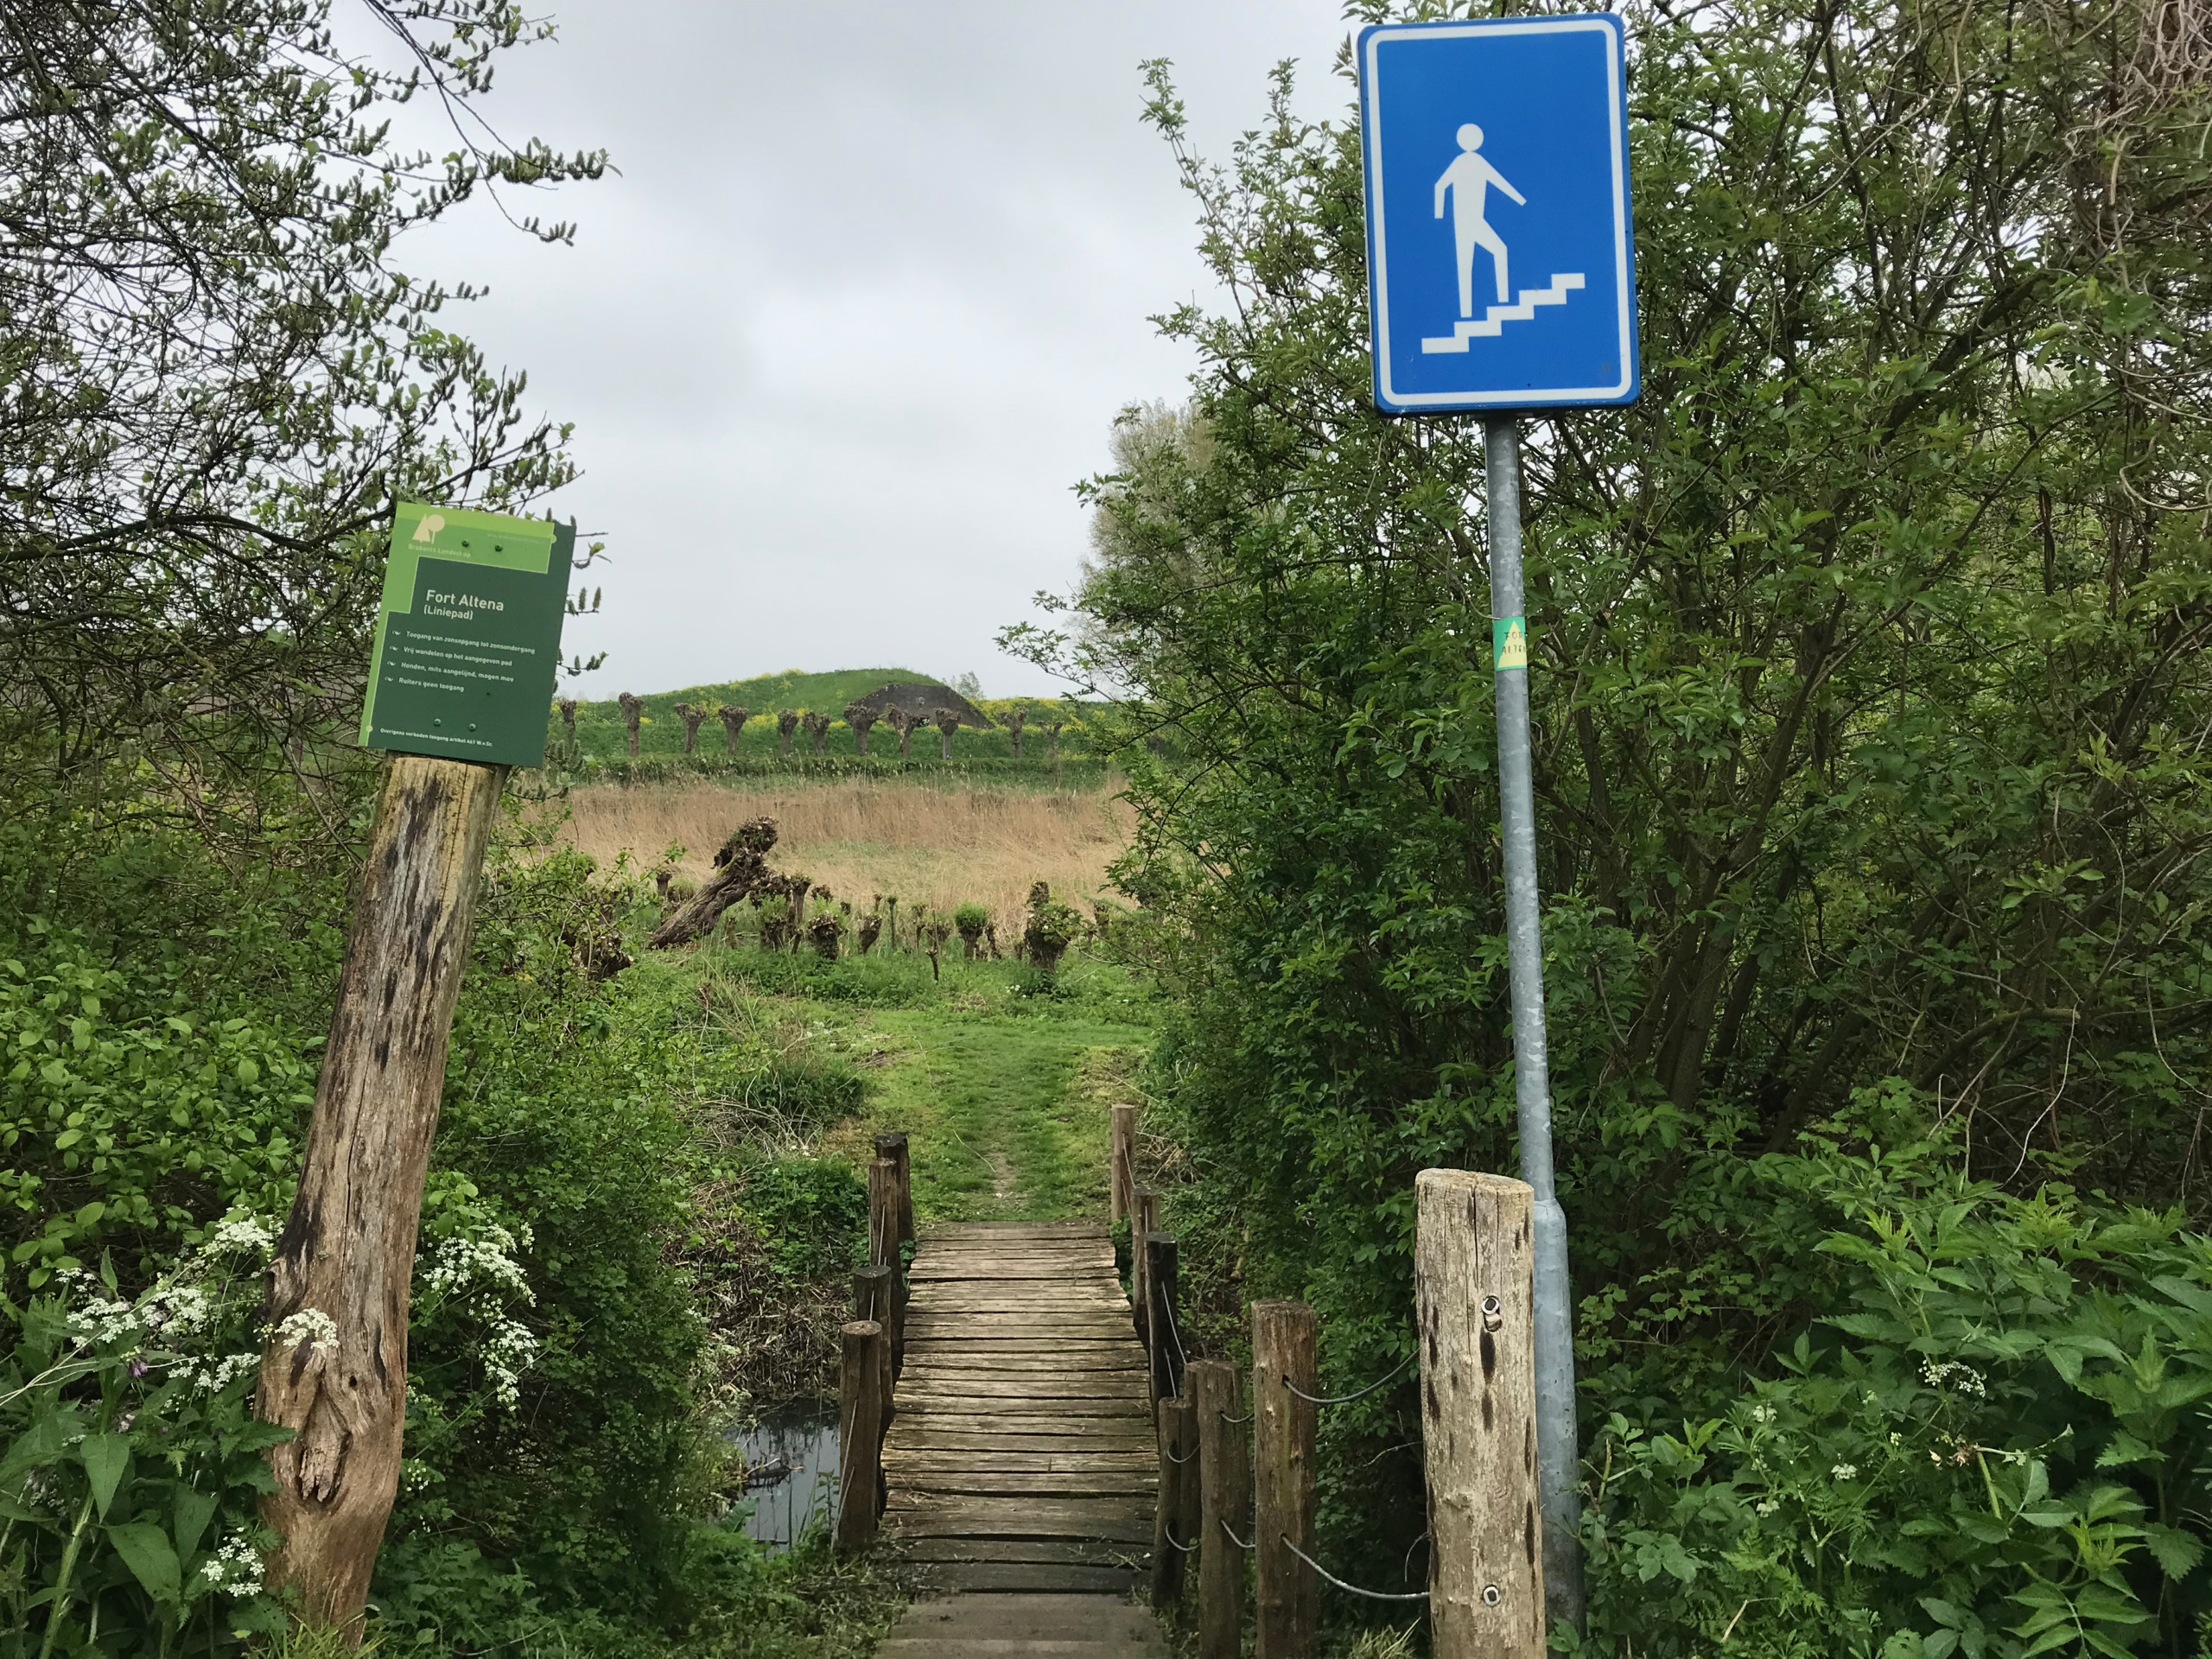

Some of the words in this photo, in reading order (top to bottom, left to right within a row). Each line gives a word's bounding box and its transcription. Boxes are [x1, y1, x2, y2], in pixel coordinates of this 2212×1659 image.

[408, 543, 436, 554] Brabants
[437, 548, 471, 559] Landschap
[426, 589, 455, 605] Fort
[458, 594, 505, 612] Altena
[423, 604, 474, 620] (Liniepad)
[406, 631, 432, 641] Toegang
[444, 636, 480, 647] zonsopgang
[490, 642, 536, 655] zonsondergang
[415, 648, 444, 658] wandelen
[464, 655, 500, 665] aangegeven
[401, 662, 427, 671] Honden,
[442, 668, 477, 678] aangelijnd,
[478, 672, 499, 681] mogen
[398, 677, 422, 686] Ruiters
[439, 683, 464, 692] toegang
